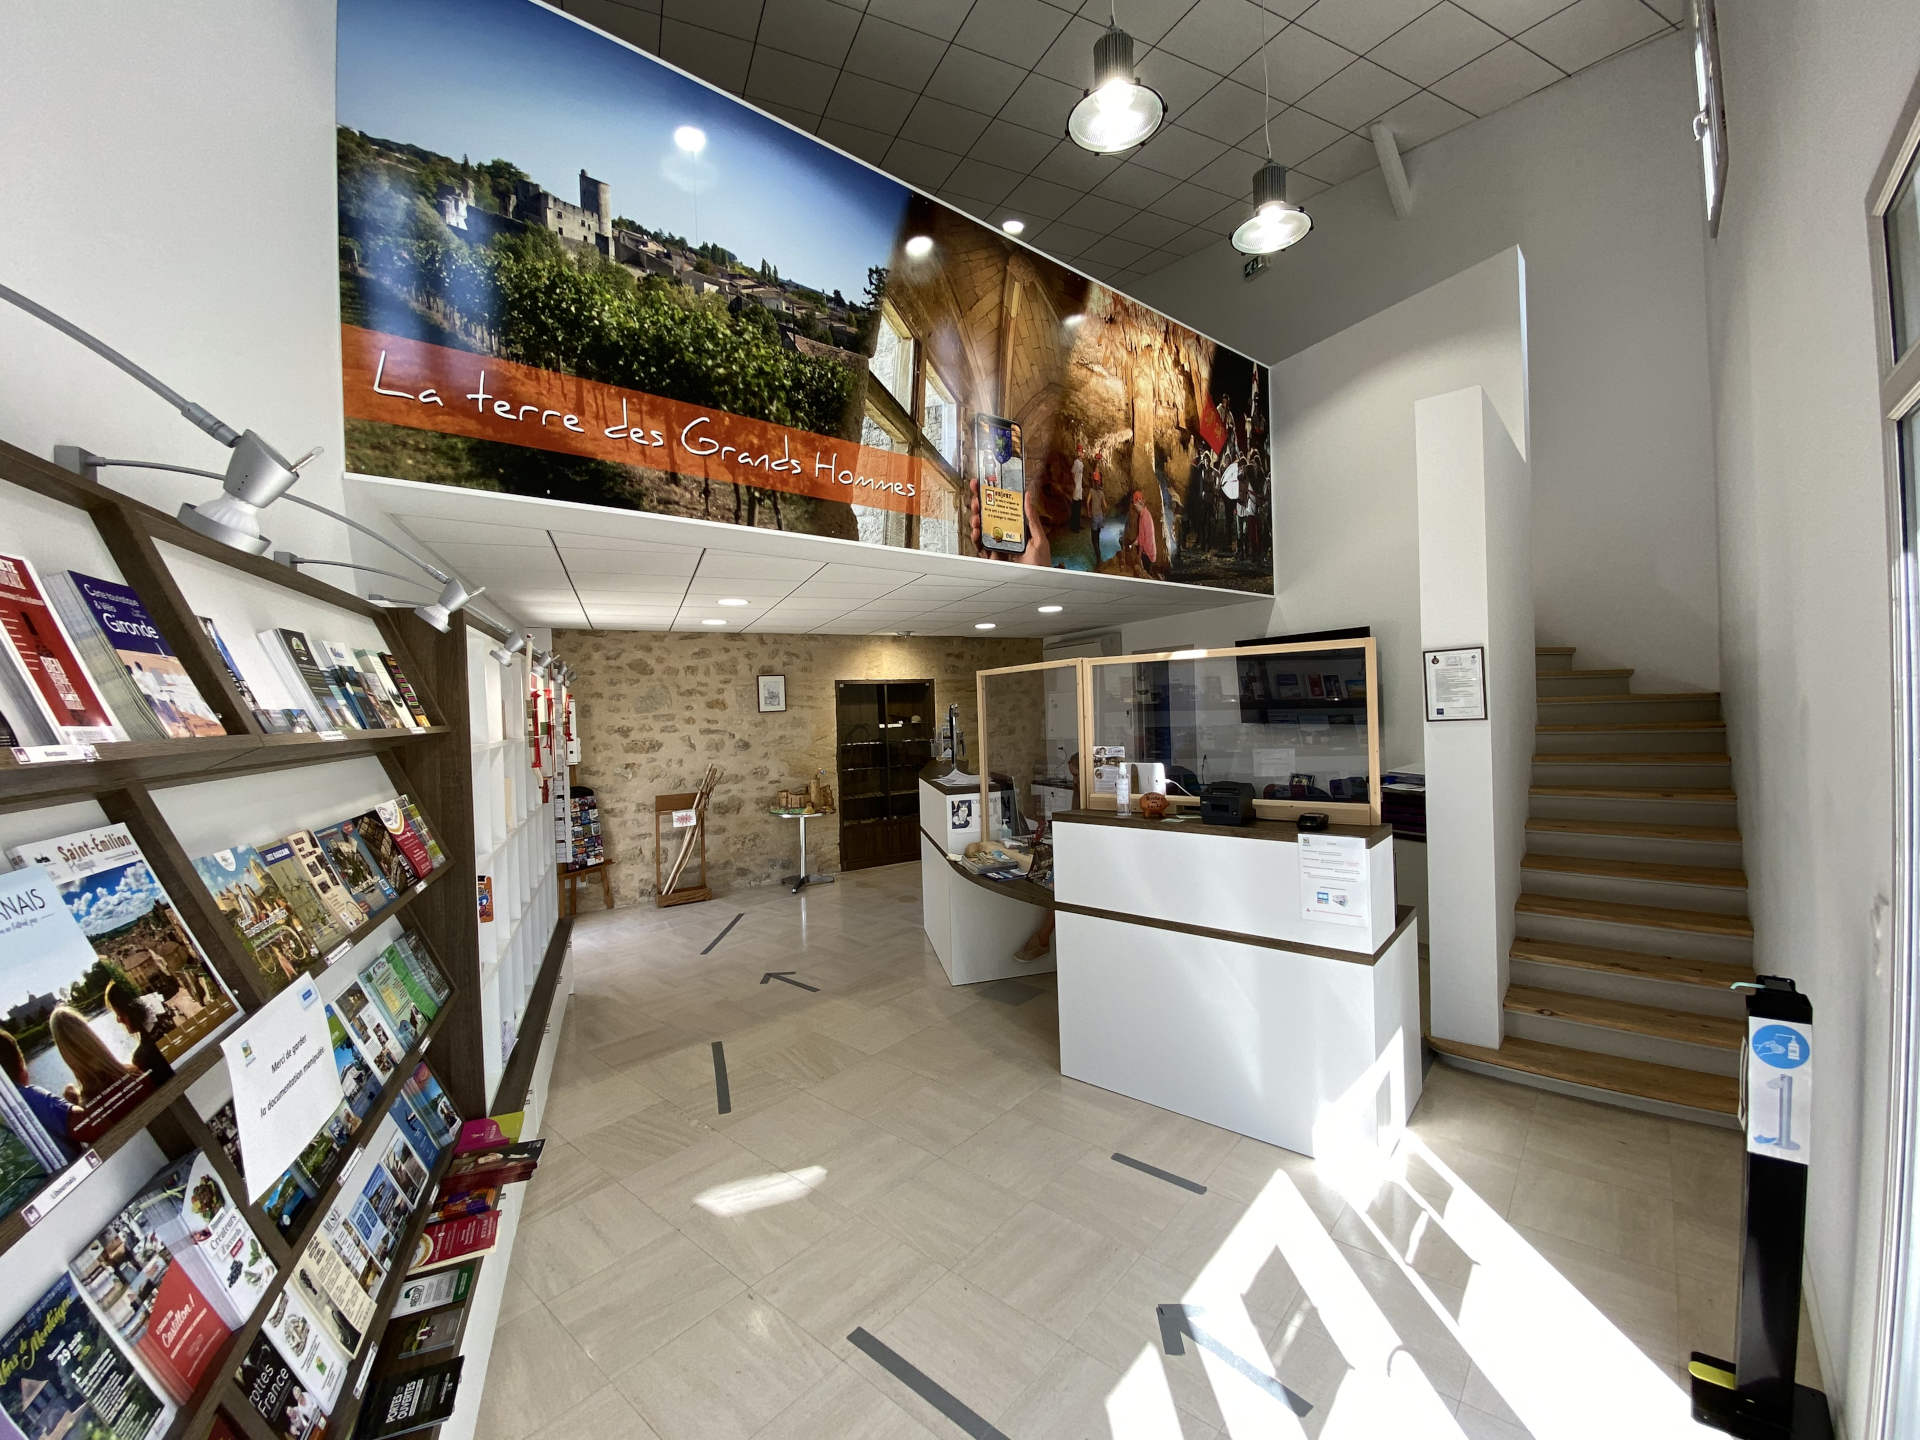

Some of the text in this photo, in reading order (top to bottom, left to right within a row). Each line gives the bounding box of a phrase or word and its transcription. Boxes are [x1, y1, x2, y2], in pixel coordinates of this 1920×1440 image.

[372, 349, 918, 499] La terre des Grands Hommes
[102, 612, 160, 640] Gironde
[56, 833, 132, 864] Saint-Émilion
[0, 887, 46, 921] NAIS
[271, 1053, 286, 1074] Merci
[267, 1069, 304, 1111] documentation
[56, 1348, 71, 1367] 29
[248, 1363, 274, 1408] rottes
[257, 1367, 289, 1419] France
